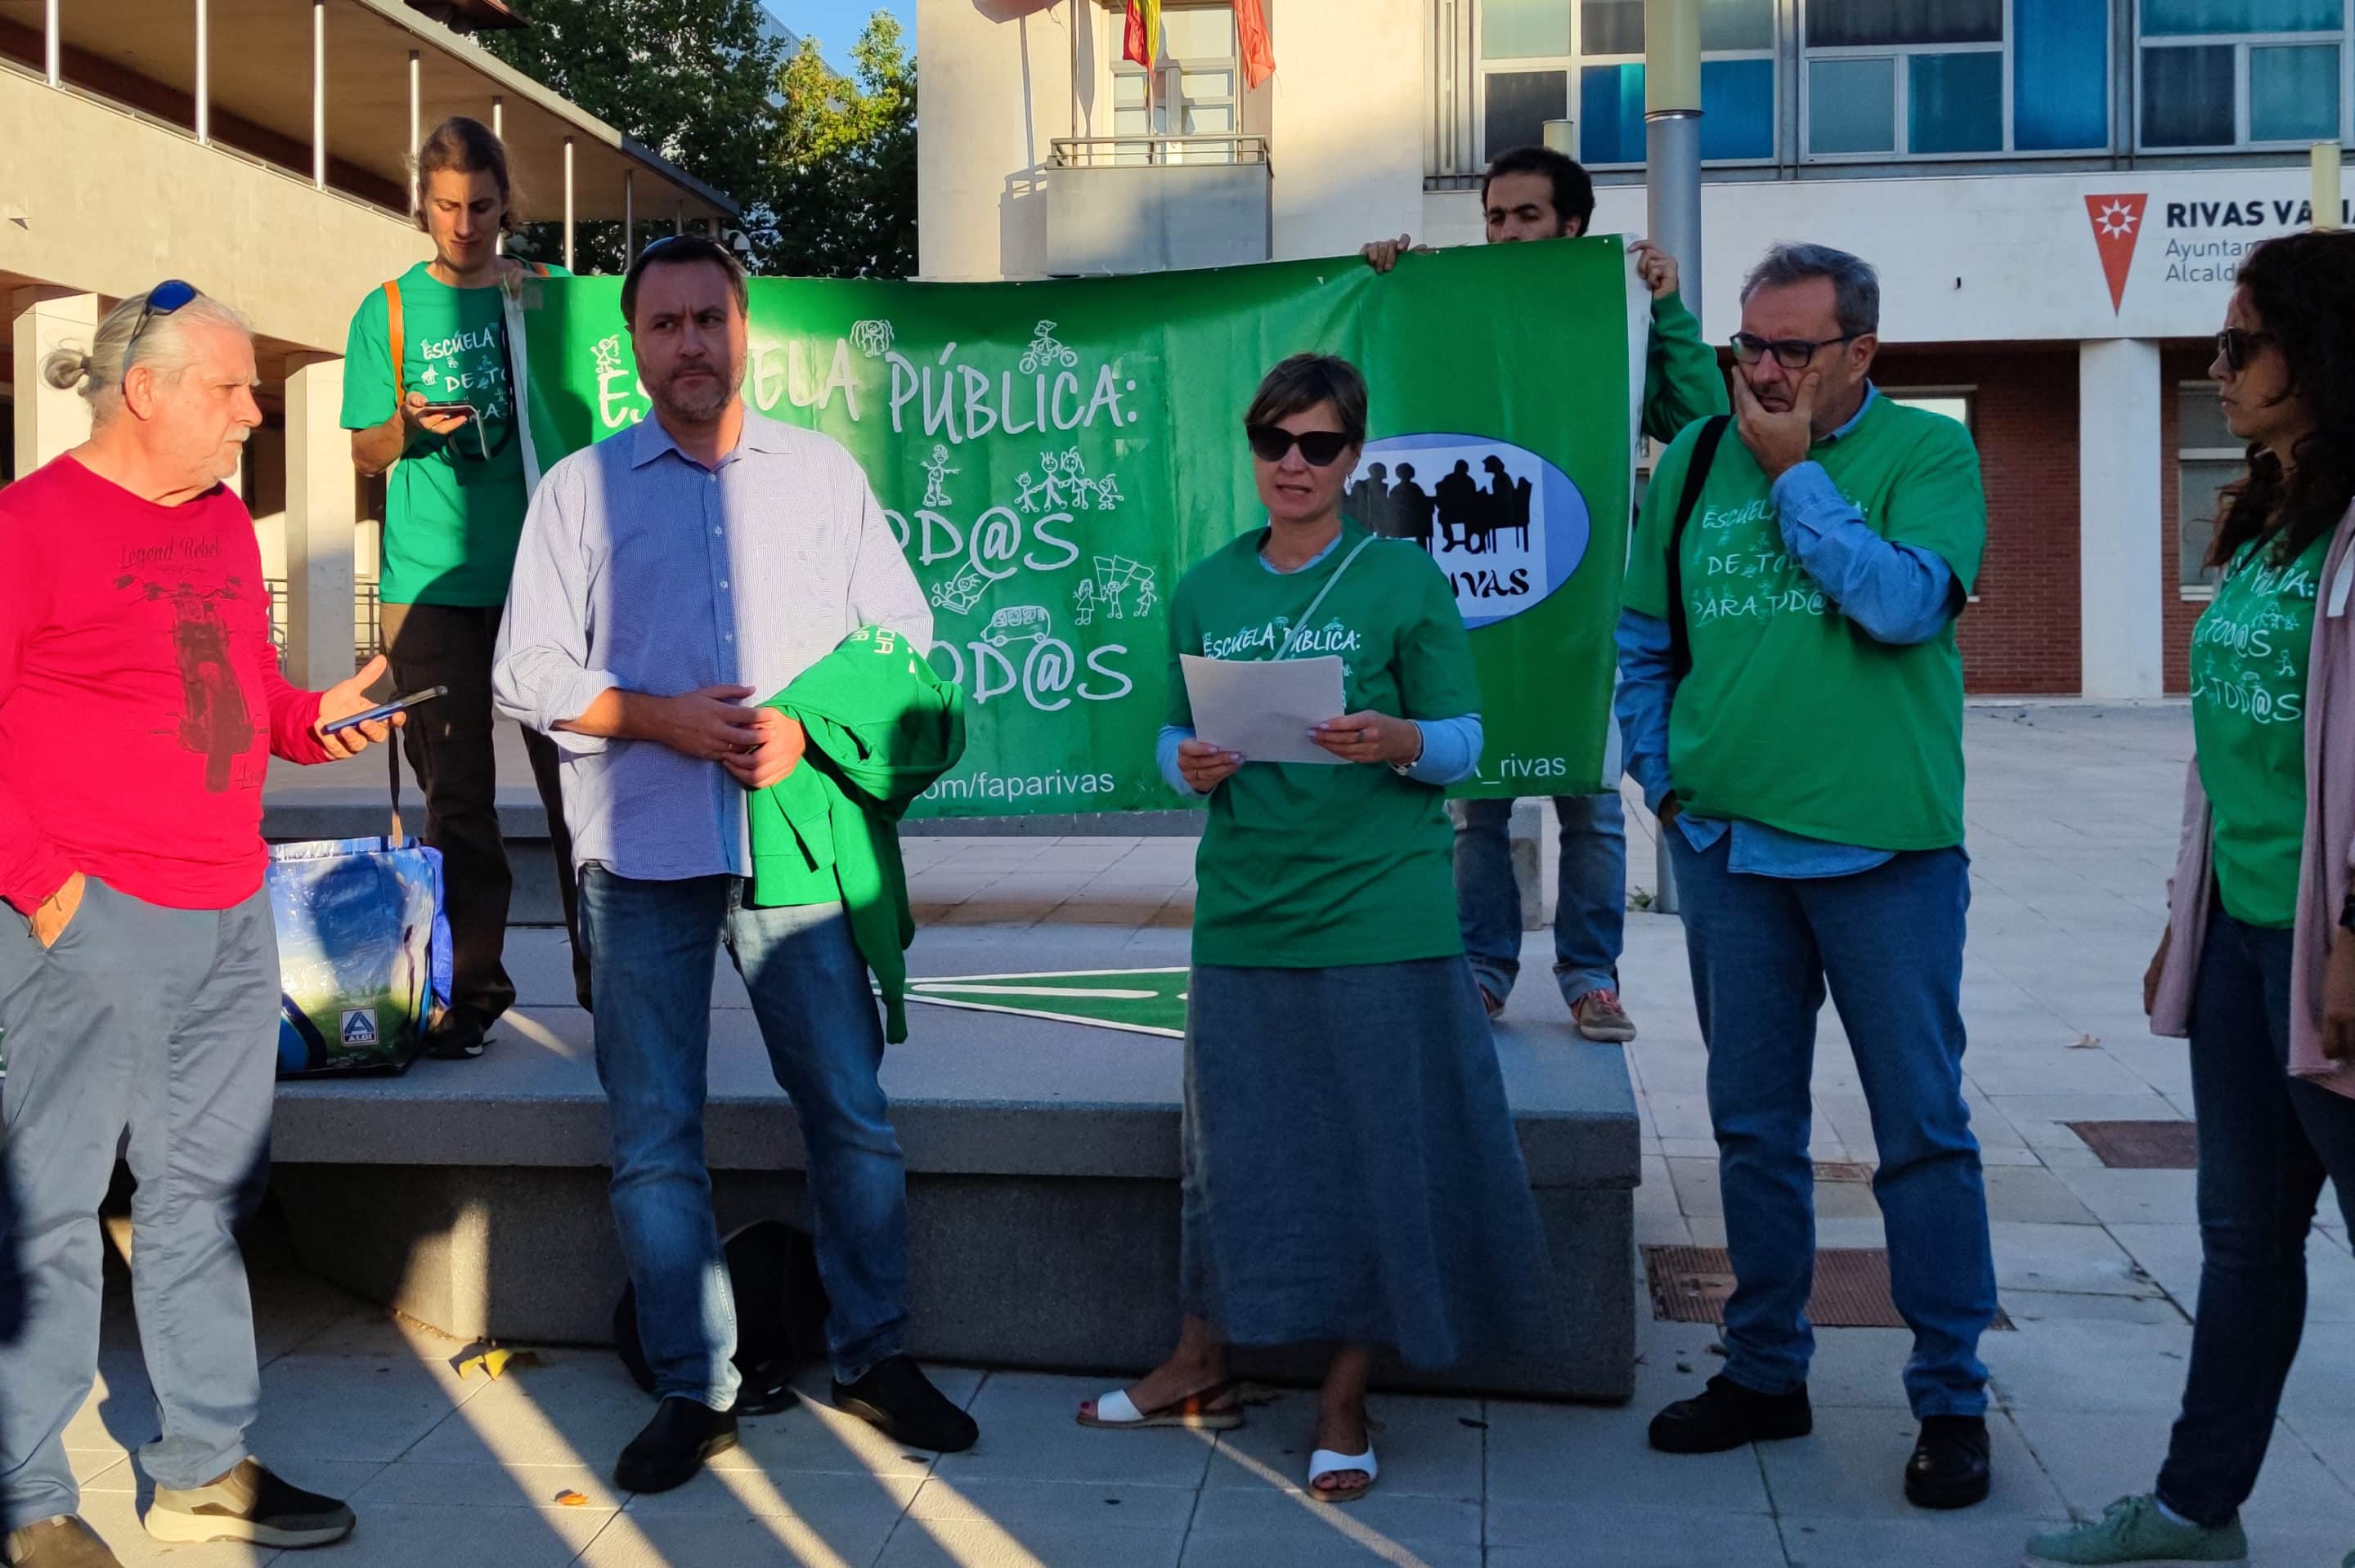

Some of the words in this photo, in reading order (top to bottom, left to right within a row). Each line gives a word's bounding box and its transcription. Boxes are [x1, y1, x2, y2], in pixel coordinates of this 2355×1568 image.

[2167, 201, 2264, 227] RIVAS
[2165, 262, 2236, 282] Alcald
[423, 327, 496, 360] ESCUELA
[444, 372, 474, 393] DE
[890, 342, 1137, 444] PÚBLICA:
[1702, 500, 1776, 529] ESCUEL
[1707, 553, 1741, 576] DE
[1451, 568, 1529, 598] IVAS
[1204, 622, 1276, 659] ESCUELA
[931, 638, 1133, 711] OD@S
[2211, 677, 2302, 724] TOD@S
[913, 769, 1115, 802] om/faparivas
